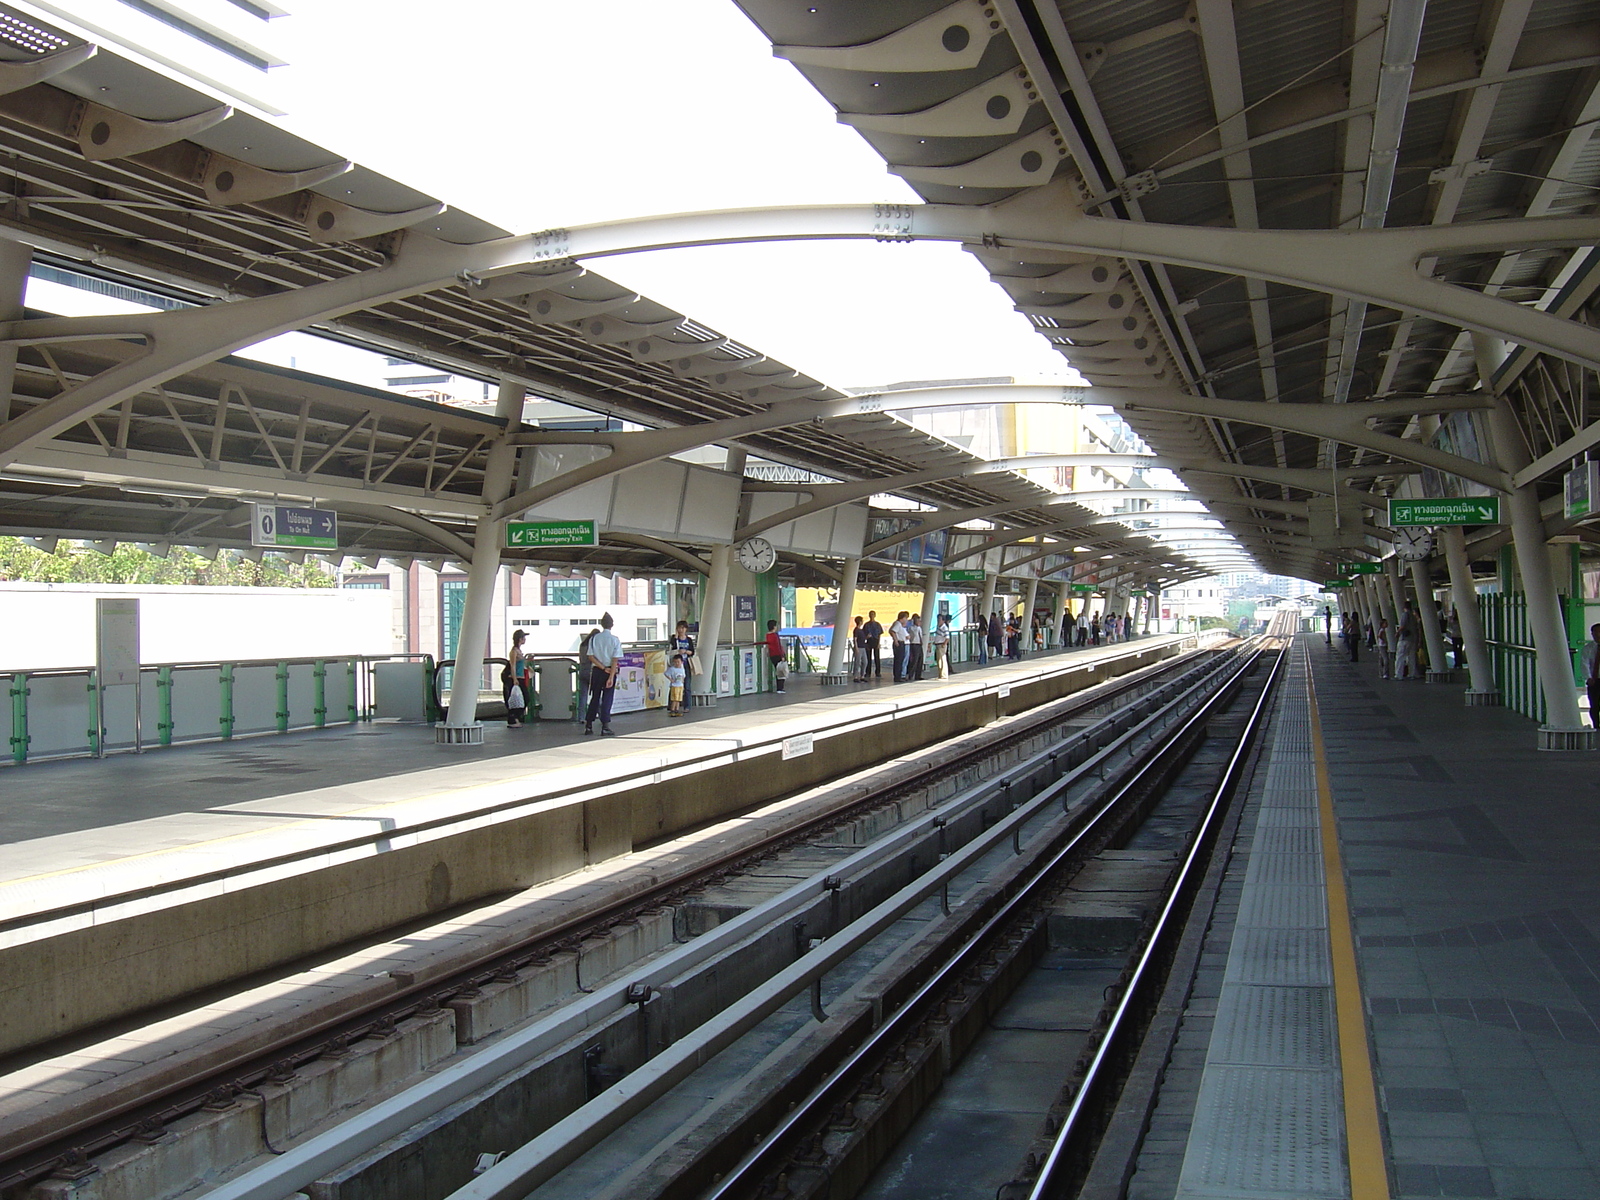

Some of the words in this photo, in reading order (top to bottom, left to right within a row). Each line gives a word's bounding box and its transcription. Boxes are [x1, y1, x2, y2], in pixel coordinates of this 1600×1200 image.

[1414, 502, 1475, 517] ทางออกฉุกเฉิน
